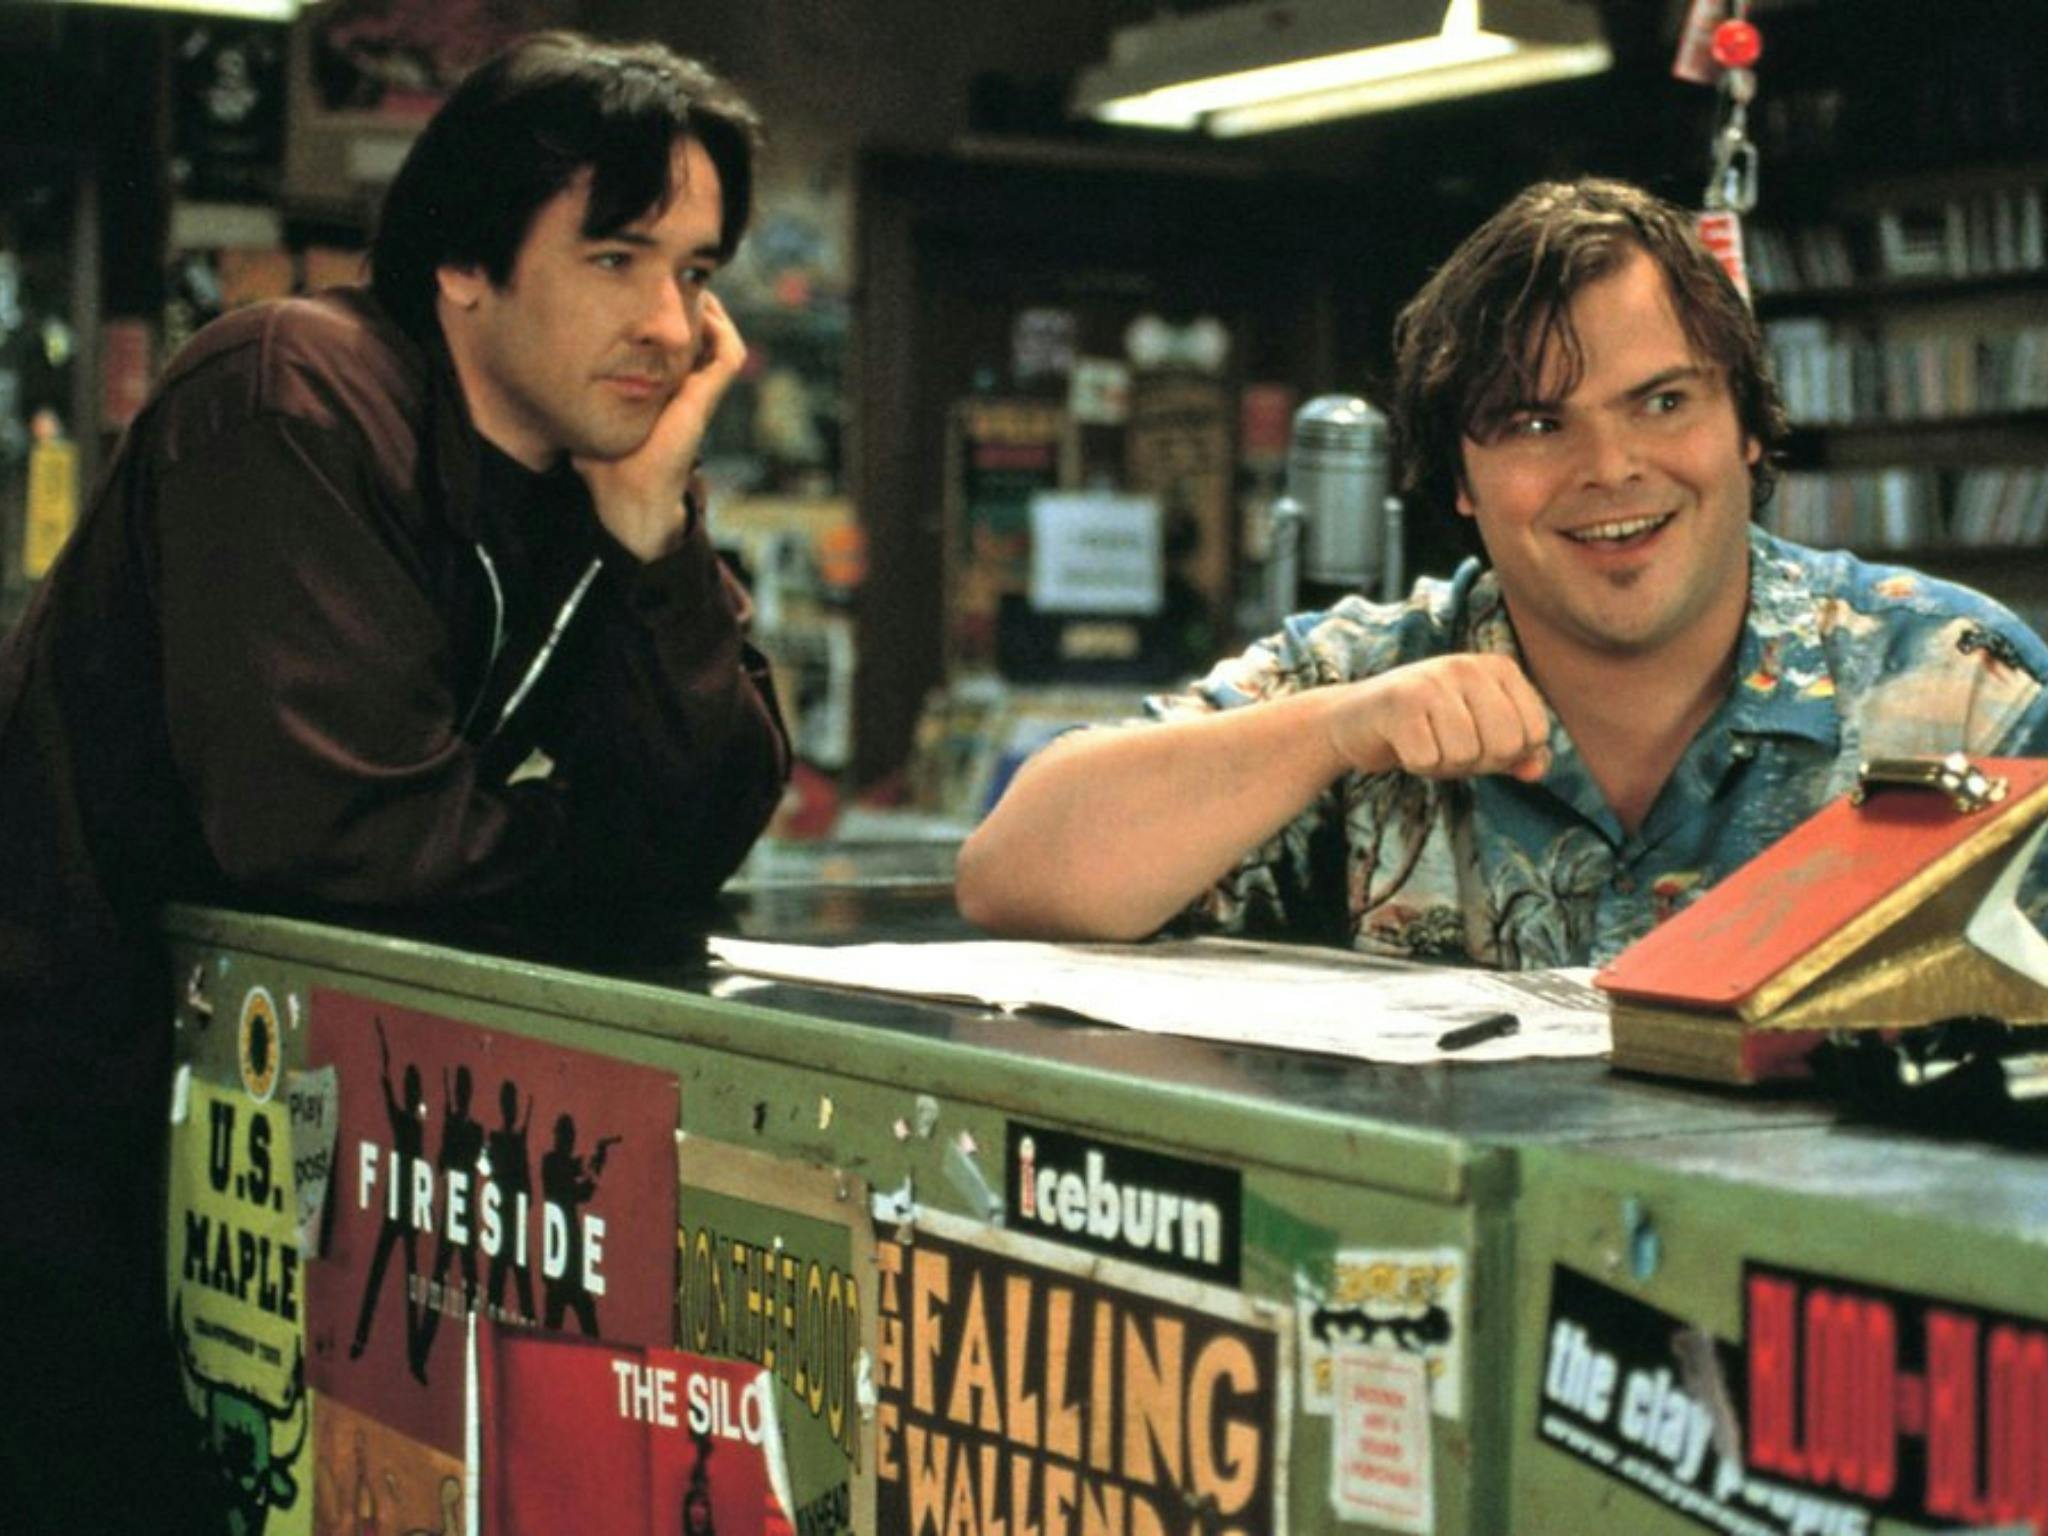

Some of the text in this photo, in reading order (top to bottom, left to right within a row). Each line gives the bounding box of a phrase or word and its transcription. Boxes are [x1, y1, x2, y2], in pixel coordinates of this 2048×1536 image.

[208, 1098, 283, 1213] U.S.
[358, 1141, 607, 1297] FIRESIDE
[1019, 1137, 1221, 1265] iceburn
[183, 1208, 298, 1323] MAPLE
[612, 1359, 679, 1429] THE
[877, 1241, 903, 1483] THE
[912, 1248, 1260, 1515] FALLING
